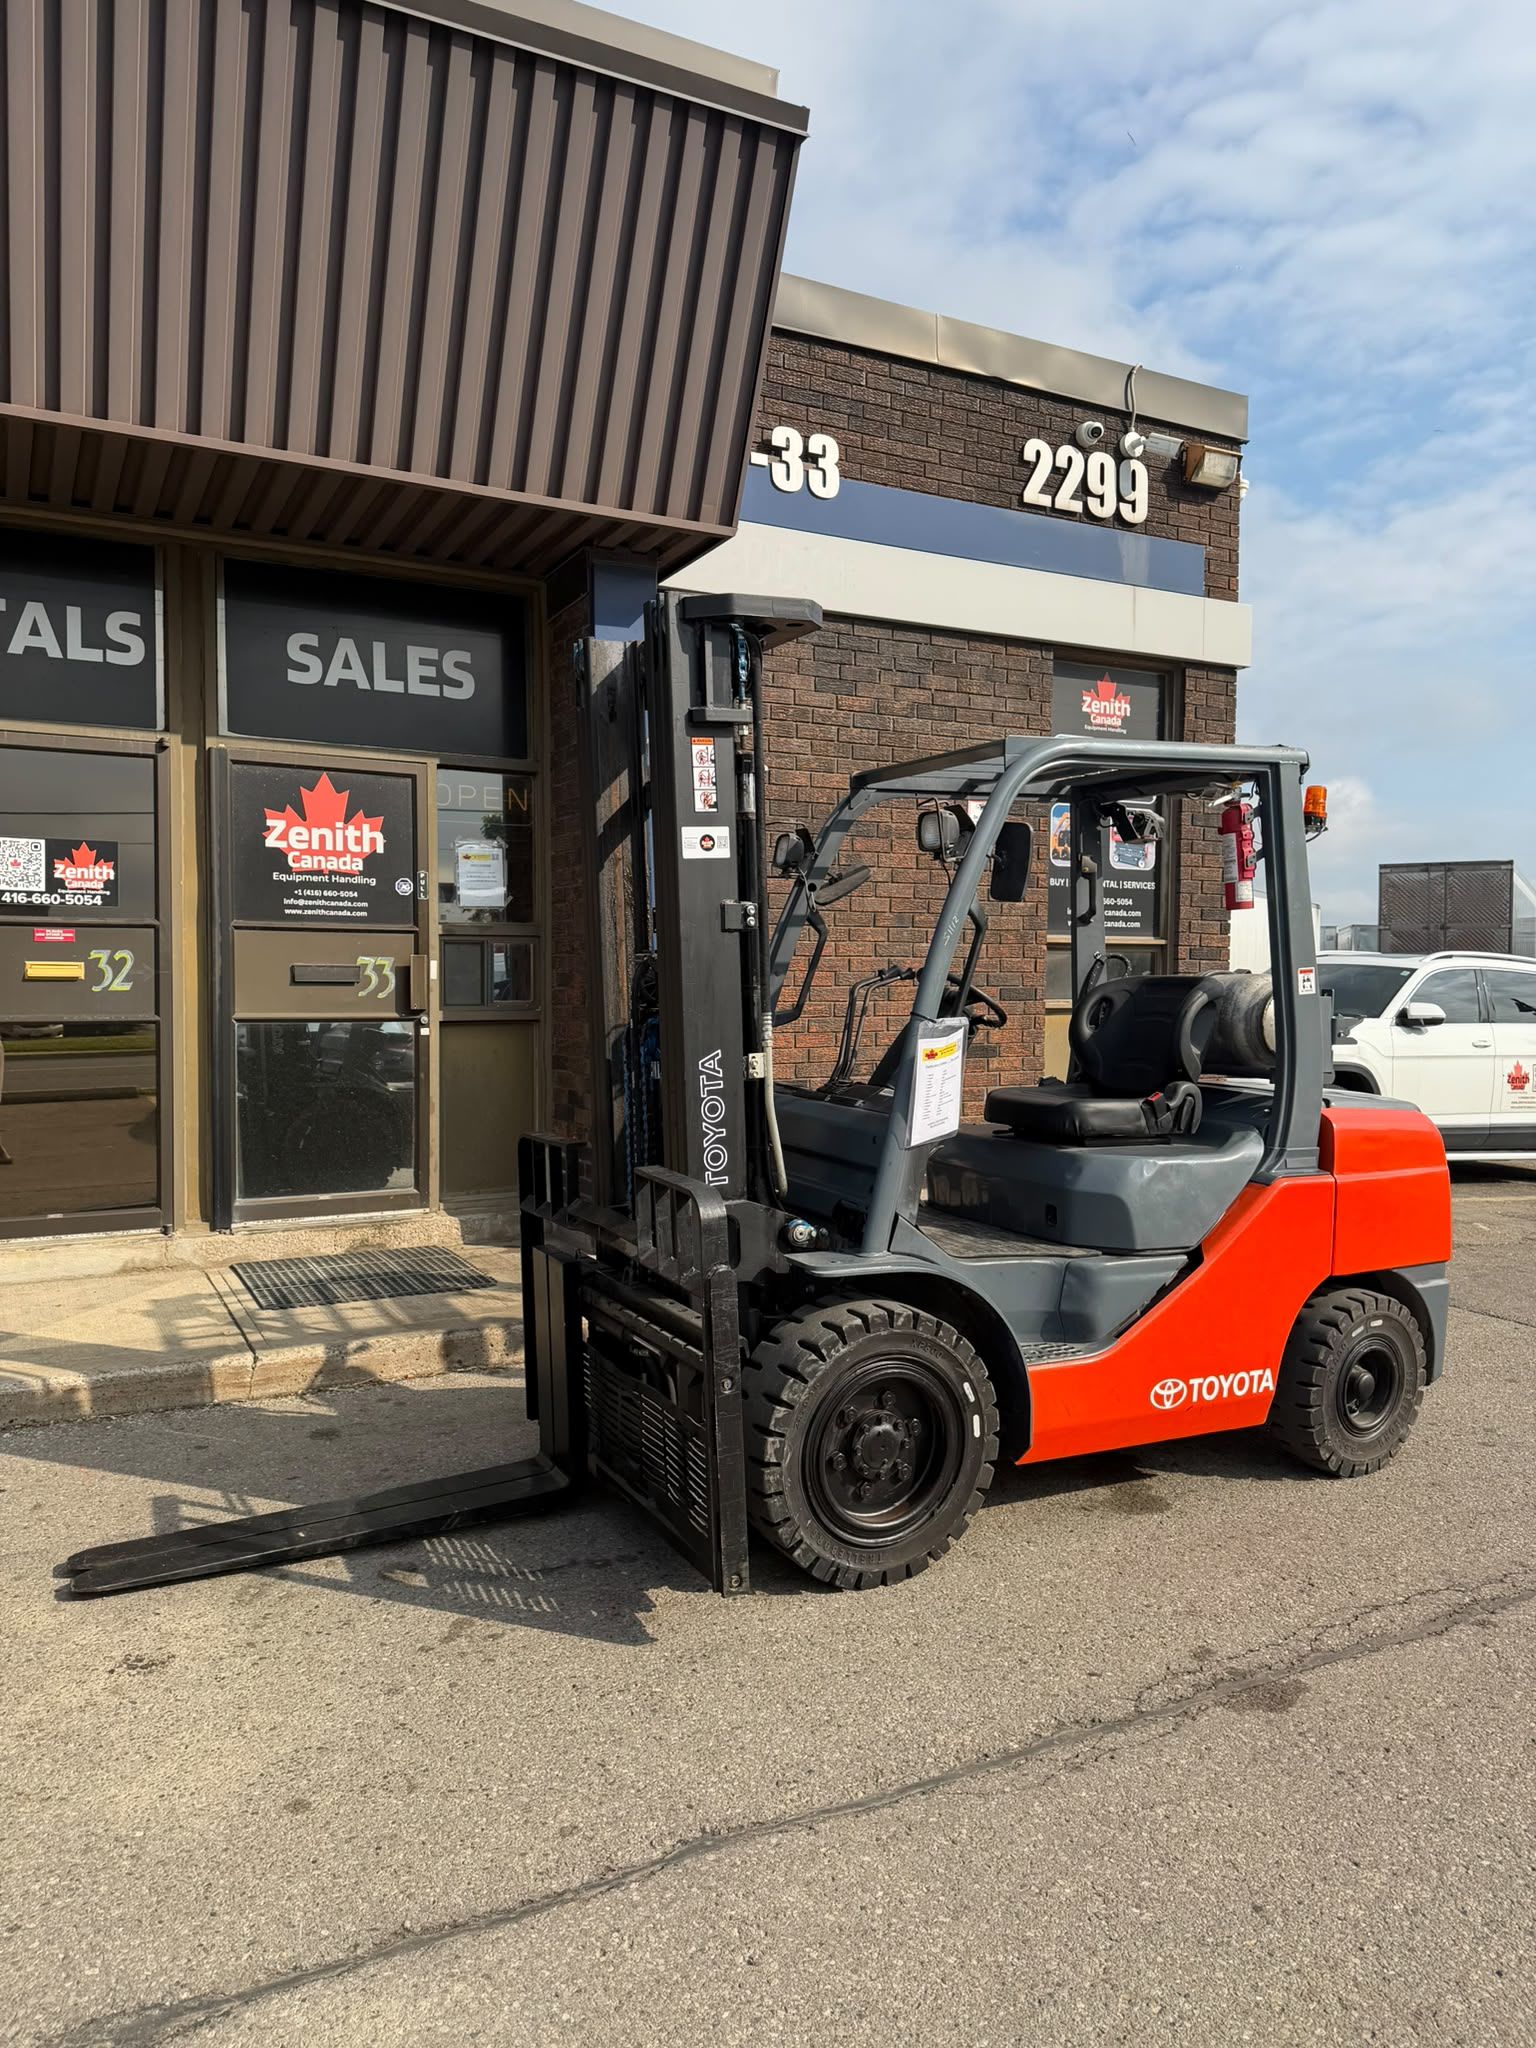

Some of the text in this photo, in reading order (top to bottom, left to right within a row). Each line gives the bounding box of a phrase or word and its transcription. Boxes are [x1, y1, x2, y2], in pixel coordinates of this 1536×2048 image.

[1023, 438, 1148, 524] 2299
[286, 632, 475, 700] SALES
[1082, 696, 1130, 716] Zenith
[1090, 713, 1121, 726] Canada
[437, 783, 528, 812] OPEN
[264, 819, 384, 854] Zenith
[287, 851, 363, 871] Canada
[54, 864, 115, 880] Zenith
[273, 871, 376, 886] Equipment Handling
[65, 879, 104, 889] Canada
[303, 889, 322, 897] (416)
[323, 890, 358, 898] 660-5054
[1049, 878, 1064, 886] BUY
[1123, 881, 1156, 890] SERVICES
[1, 892, 103, 906] 416-660-5054
[283, 898, 369, 907] info@zenithcanada.com
[284, 908, 368, 917] www.zenithcanada.com
[88, 949, 134, 992] 32
[356, 956, 396, 998] 33
[699, 1049, 728, 1186] TOYOTA
[1188, 1368, 1274, 1403] TOYOTA
